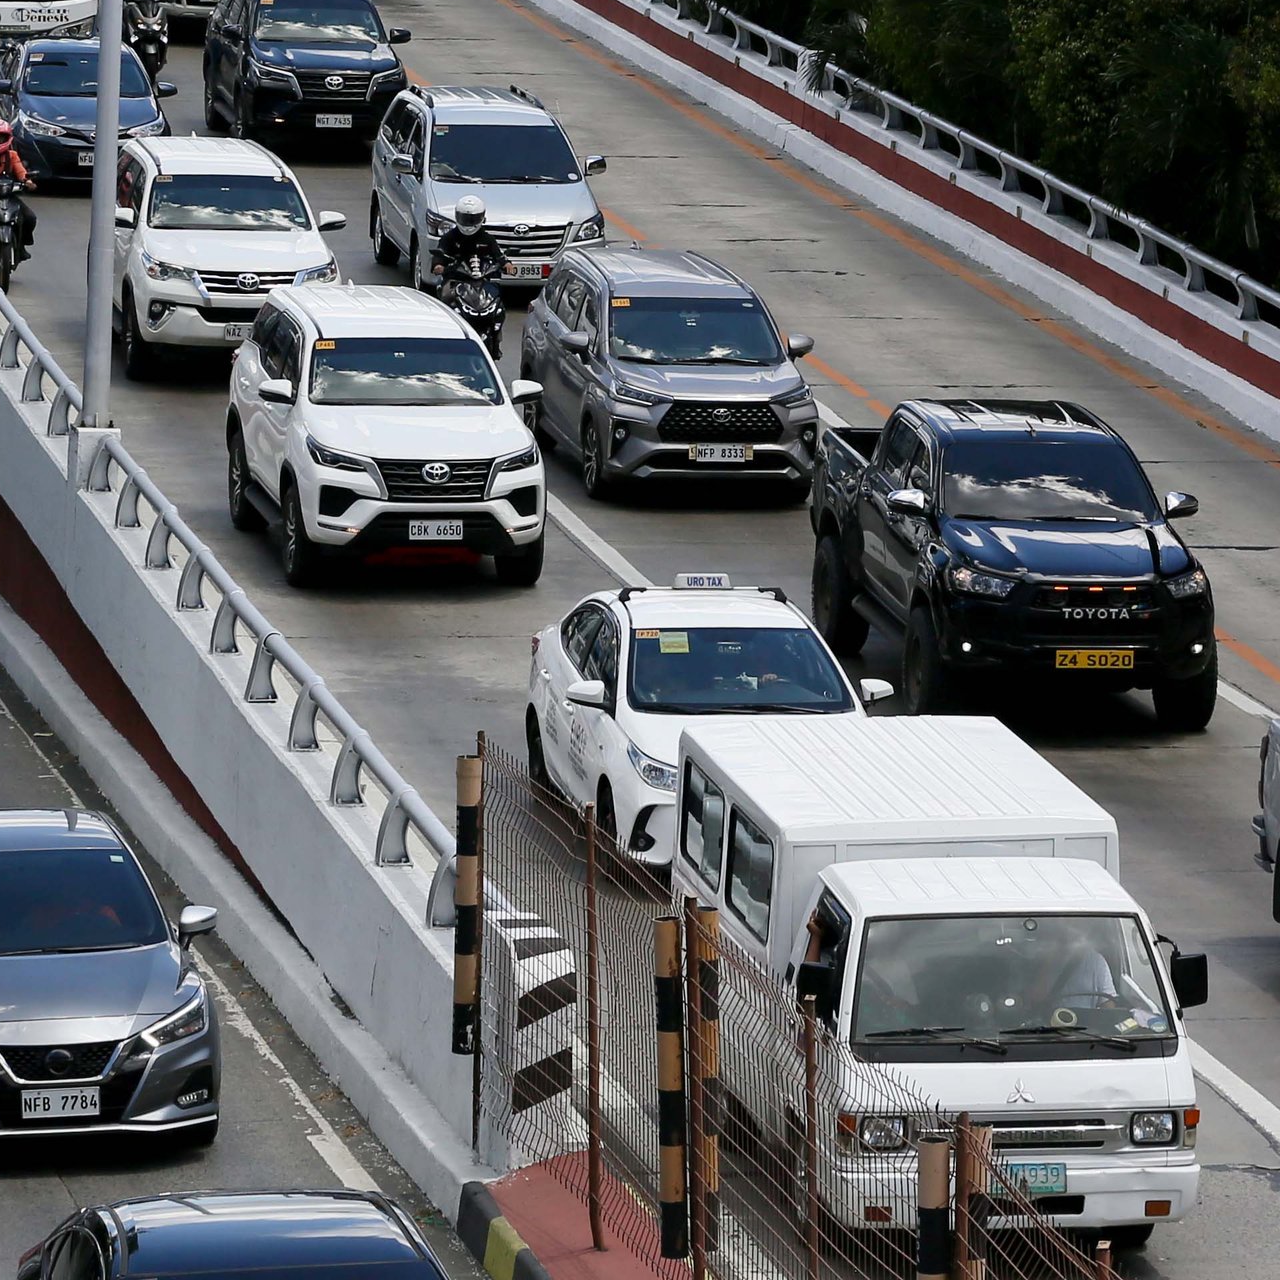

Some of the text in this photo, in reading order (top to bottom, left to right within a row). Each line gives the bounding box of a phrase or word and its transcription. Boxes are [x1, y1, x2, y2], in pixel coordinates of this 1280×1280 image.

[520, 265, 541, 276] 8993
[697, 448, 744, 460] NFP 8333
[410, 524, 462, 536] CBK 6650
[1062, 608, 1130, 619] TOYOTA
[1058, 654, 1078, 667] Z4
[23, 1094, 98, 1113] NFB 7784
[1029, 1166, 1060, 1184] 939
